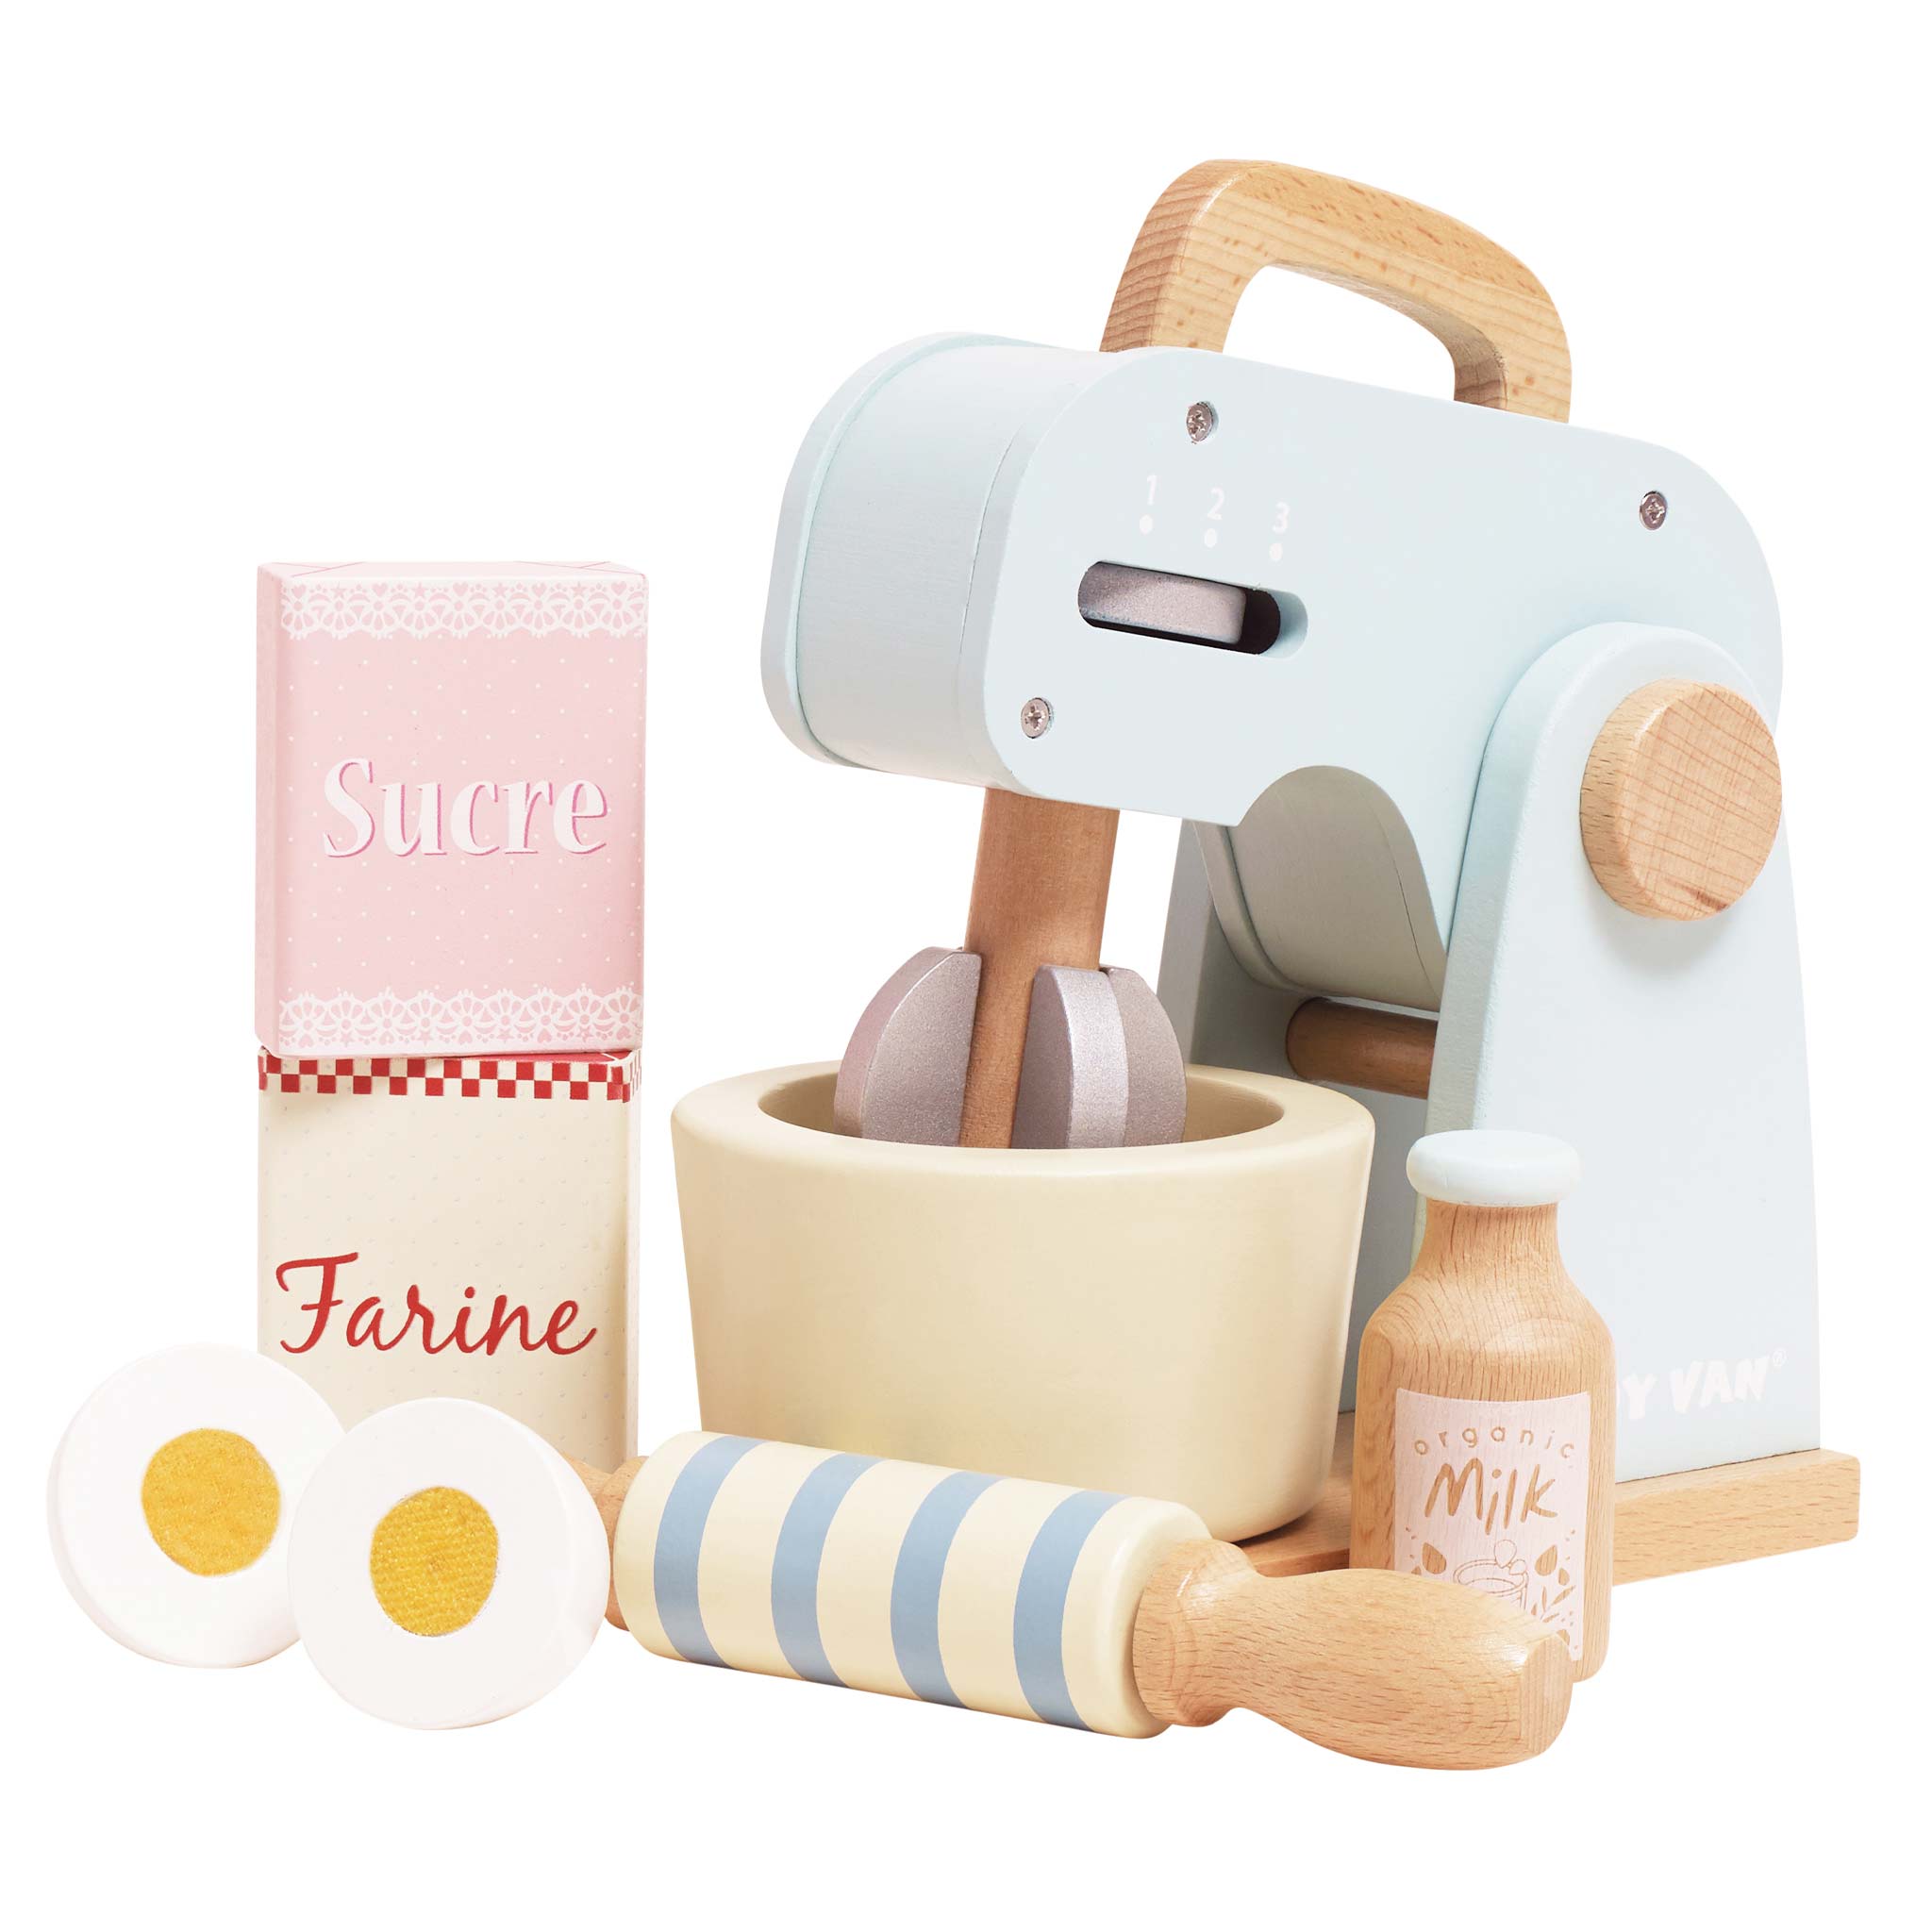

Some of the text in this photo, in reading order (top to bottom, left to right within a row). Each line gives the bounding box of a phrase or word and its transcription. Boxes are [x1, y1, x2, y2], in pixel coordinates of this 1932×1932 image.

[1146, 475, 1291, 534] 1 2 3
[323, 758, 608, 858] Sucre
[275, 1252, 597, 1356] Farine
[1615, 1372, 1657, 1419] Y
[1415, 1426, 1574, 1458] organic
[1424, 1457, 1557, 1535] Milk
